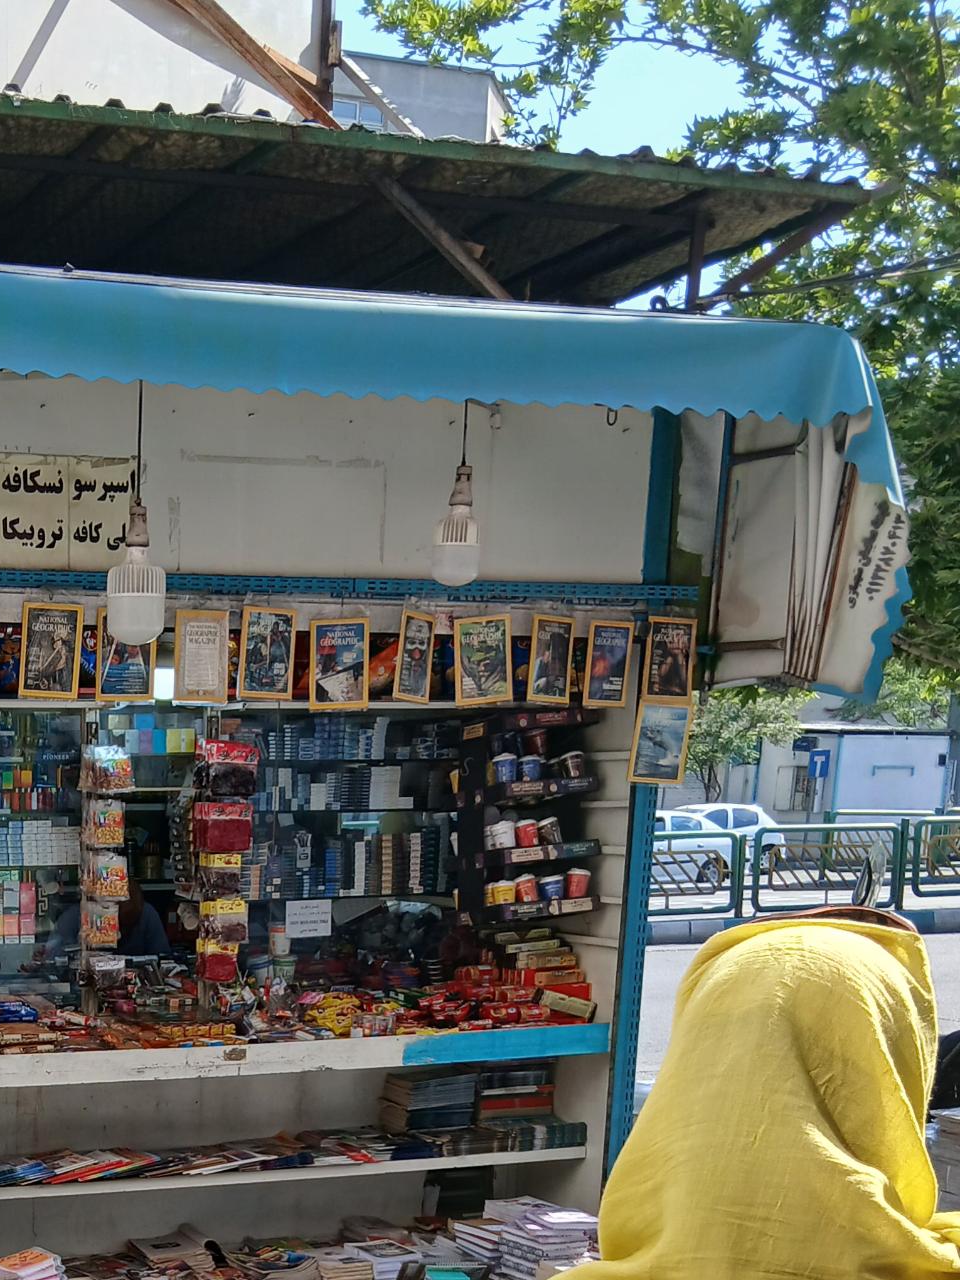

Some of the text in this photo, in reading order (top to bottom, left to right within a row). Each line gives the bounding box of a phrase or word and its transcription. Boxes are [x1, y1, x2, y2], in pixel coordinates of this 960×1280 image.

[2, 466, 64, 494] نسکافه
[73, 519, 103, 544] کافه
[106, 522, 128, 551] لی
[38, 615, 69, 624] NATIONAL
[31, 622, 75, 634] GEOGRAPHIC
[326, 630, 356, 639] NATIONAL
[319, 636, 361, 647] GEOGRAPHIC
[42, 753, 70, 761] PIONEER
